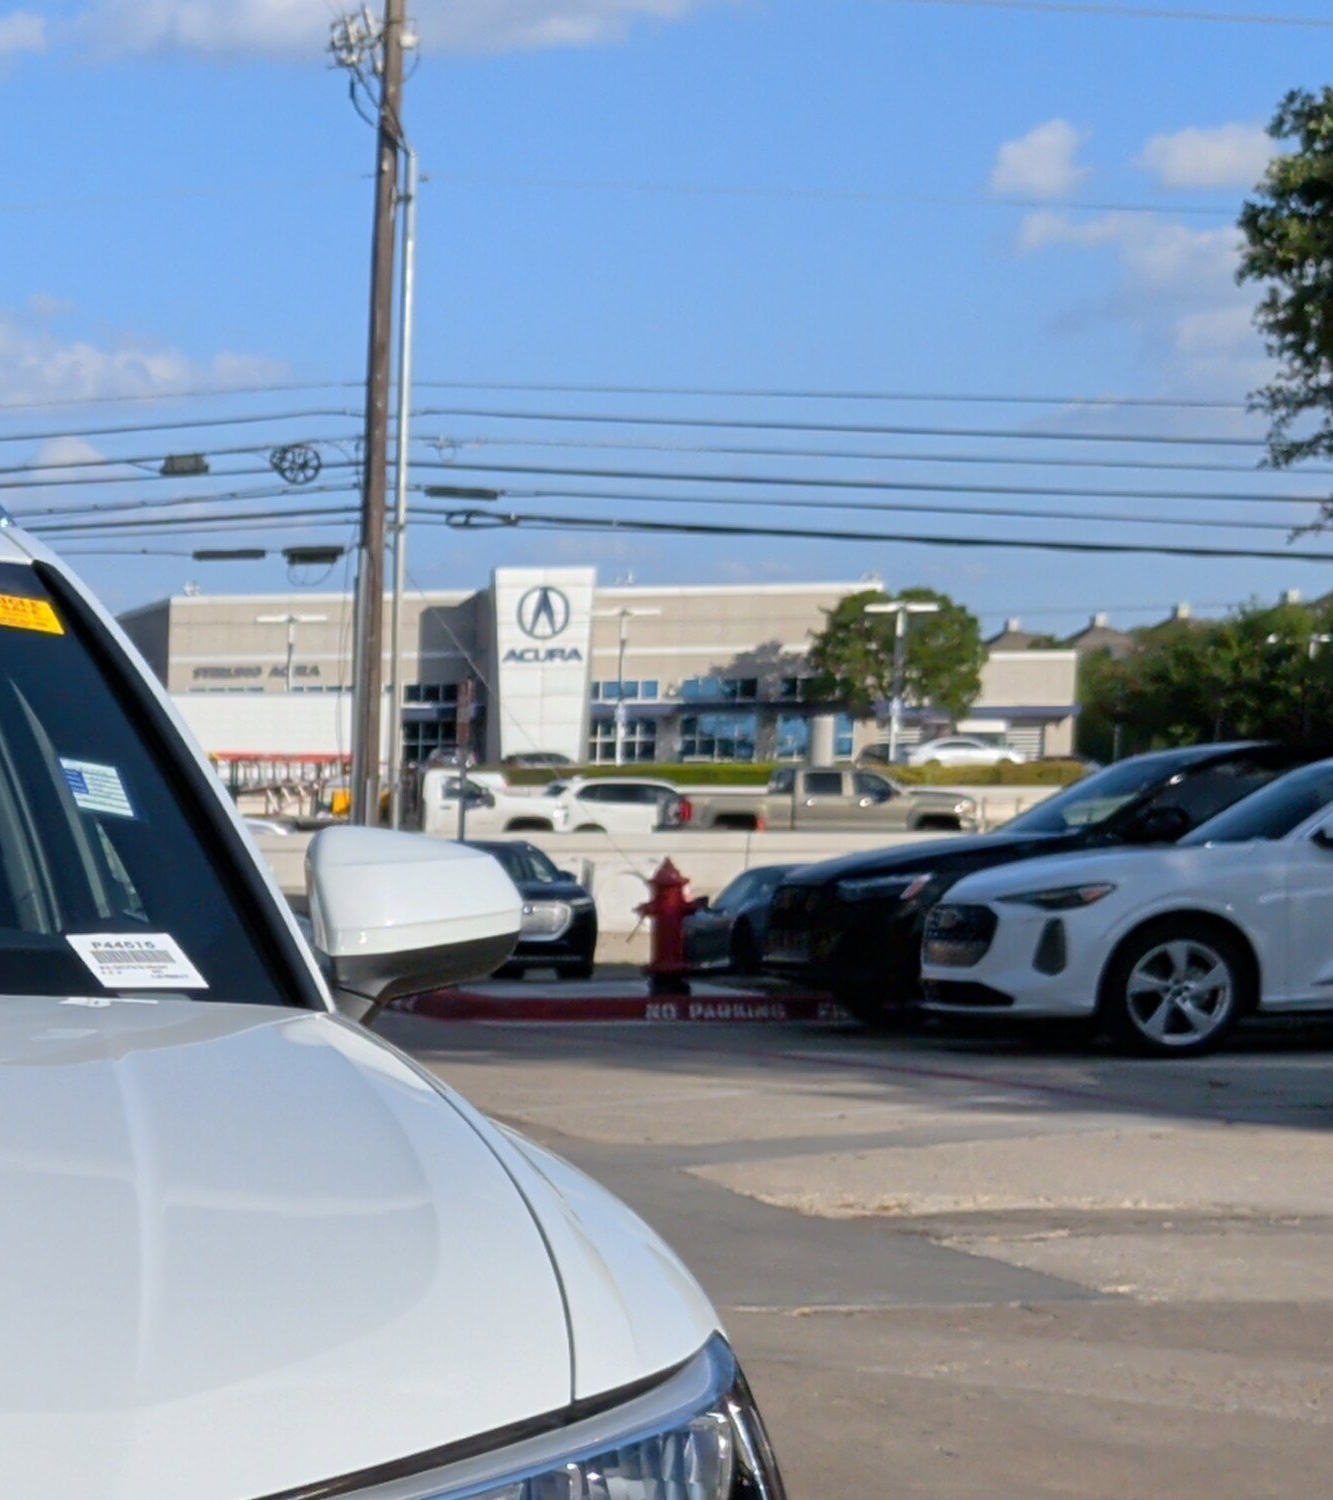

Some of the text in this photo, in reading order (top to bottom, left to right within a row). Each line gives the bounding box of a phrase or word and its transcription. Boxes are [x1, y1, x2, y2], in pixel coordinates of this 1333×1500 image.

[502, 648, 583, 662] ACURA
[645, 1003, 677, 1019] NO
[689, 1003, 786, 1019] PARKING
